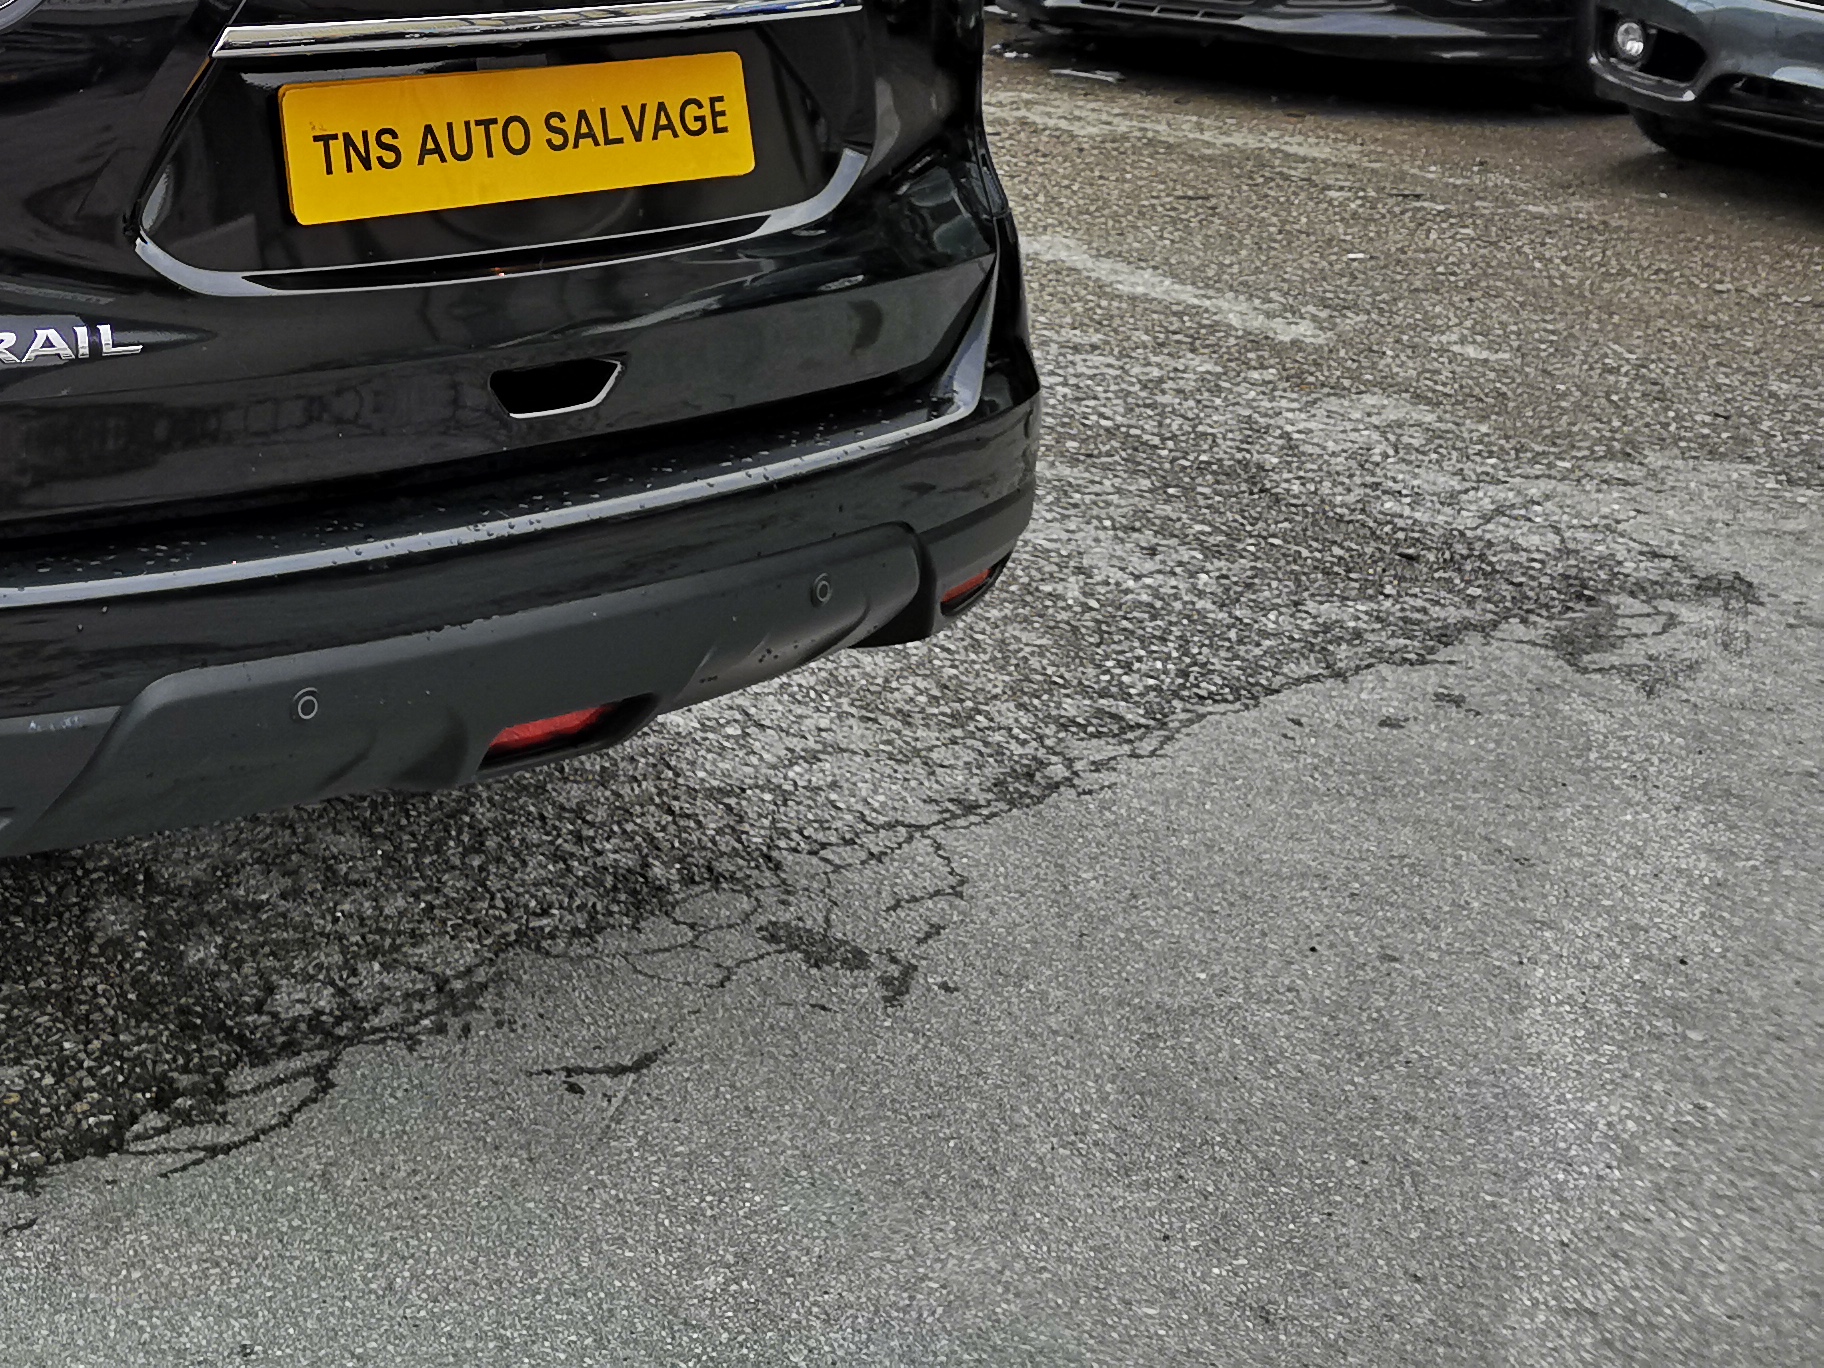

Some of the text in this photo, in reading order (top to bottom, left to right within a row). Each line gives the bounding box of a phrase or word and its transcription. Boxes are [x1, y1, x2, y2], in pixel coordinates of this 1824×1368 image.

[313, 95, 729, 176] TNS AUTO SALVAGE
